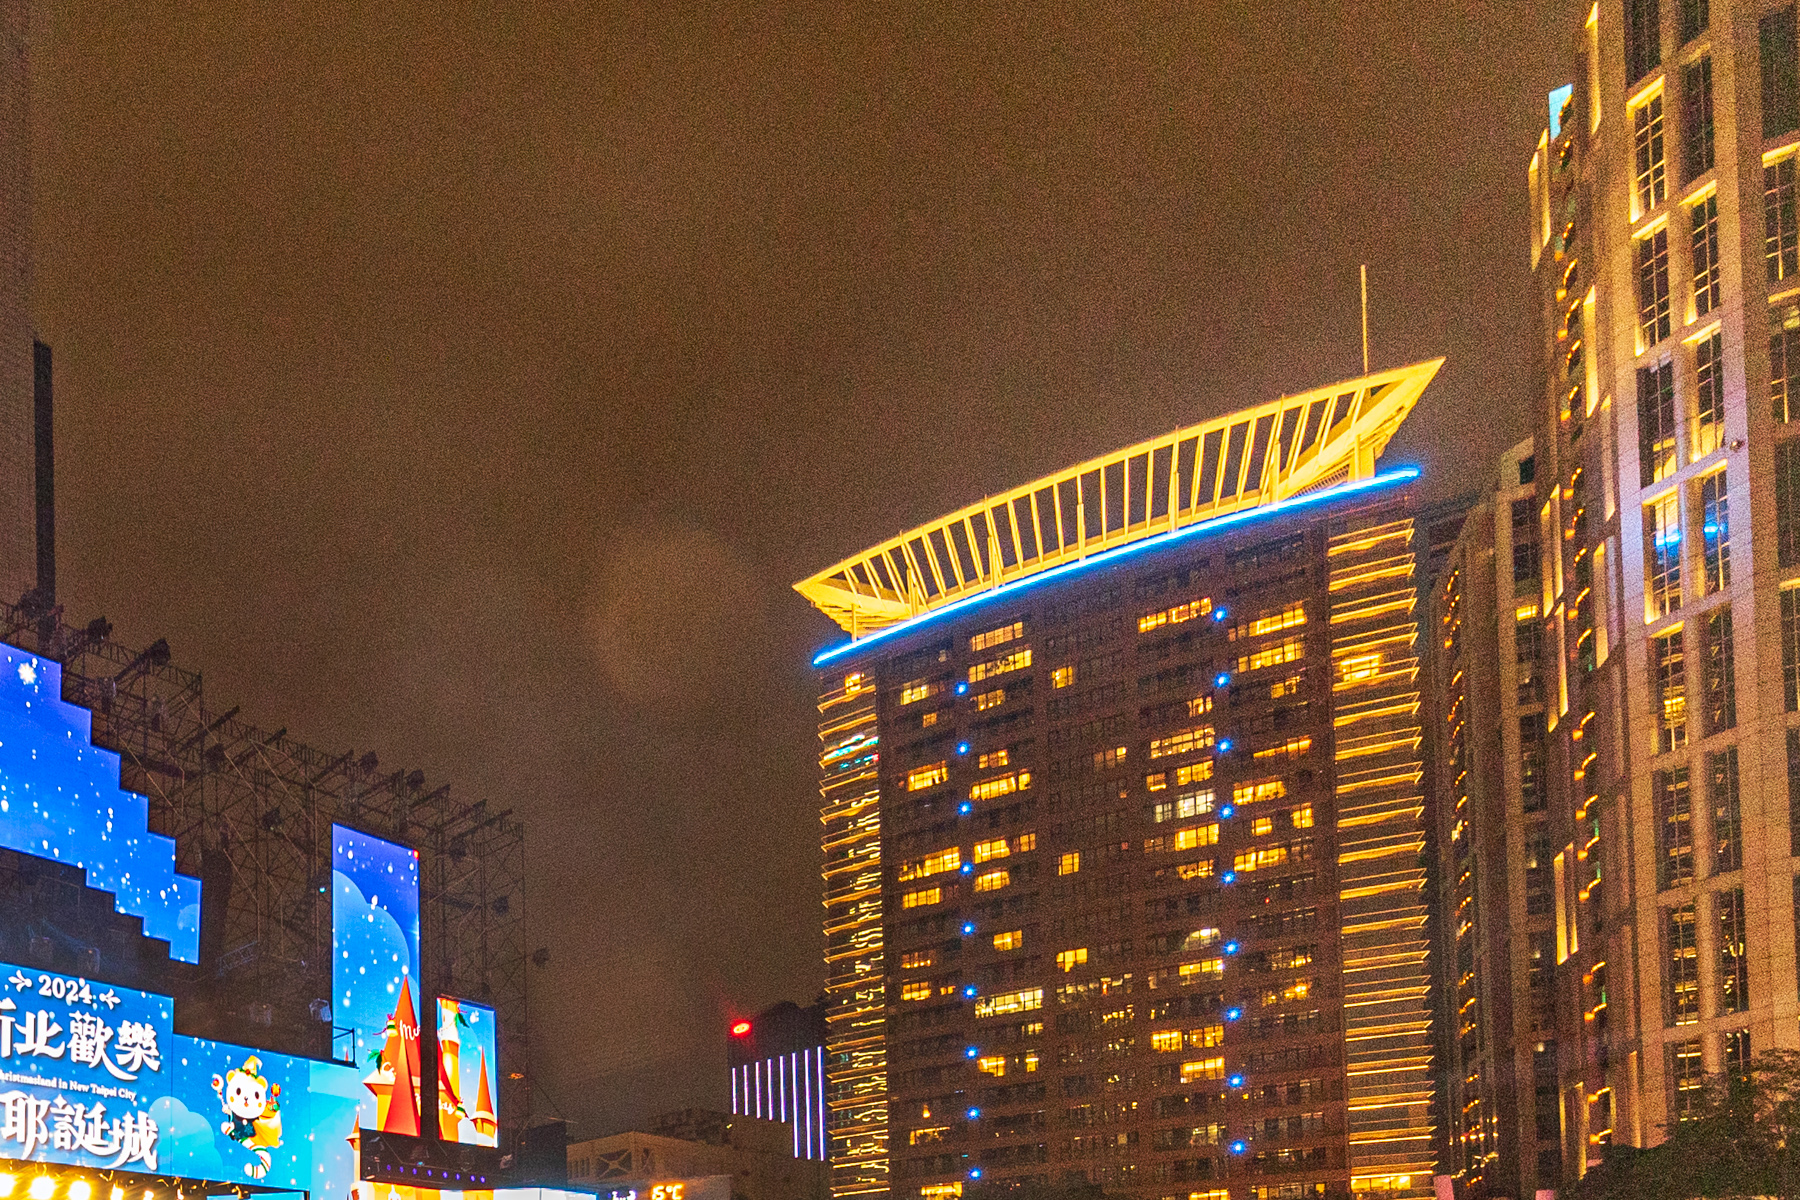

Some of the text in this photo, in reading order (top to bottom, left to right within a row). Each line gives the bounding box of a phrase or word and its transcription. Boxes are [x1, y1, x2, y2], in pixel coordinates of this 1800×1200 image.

[38, 974, 93, 1005] 2024
[58, 1078, 68, 1090] in
[69, 1080, 90, 1093] New
[90, 1083, 117, 1098] Taipei
[117, 1088, 137, 1102] City
[0, 1094, 159, 1172] 耶誕城
